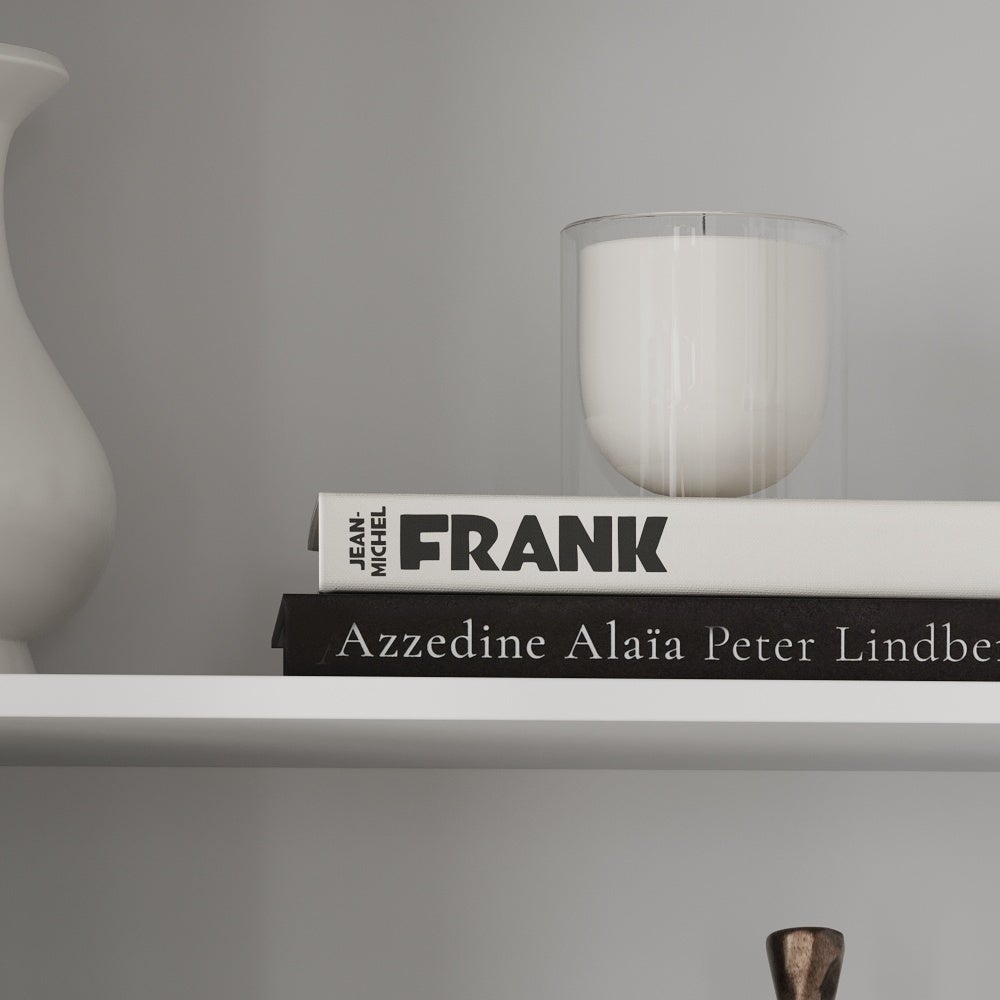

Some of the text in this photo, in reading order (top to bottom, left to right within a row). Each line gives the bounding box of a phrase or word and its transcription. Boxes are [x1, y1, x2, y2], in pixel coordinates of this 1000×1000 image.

[349, 511, 365, 570] JEAN-
[370, 506, 387, 577] MICHEL
[400, 514, 668, 573] FRANK
[335, 619, 546, 659] Azzedine
[565, 620, 685, 661] Alaïa
[703, 625, 815, 662] Peter
